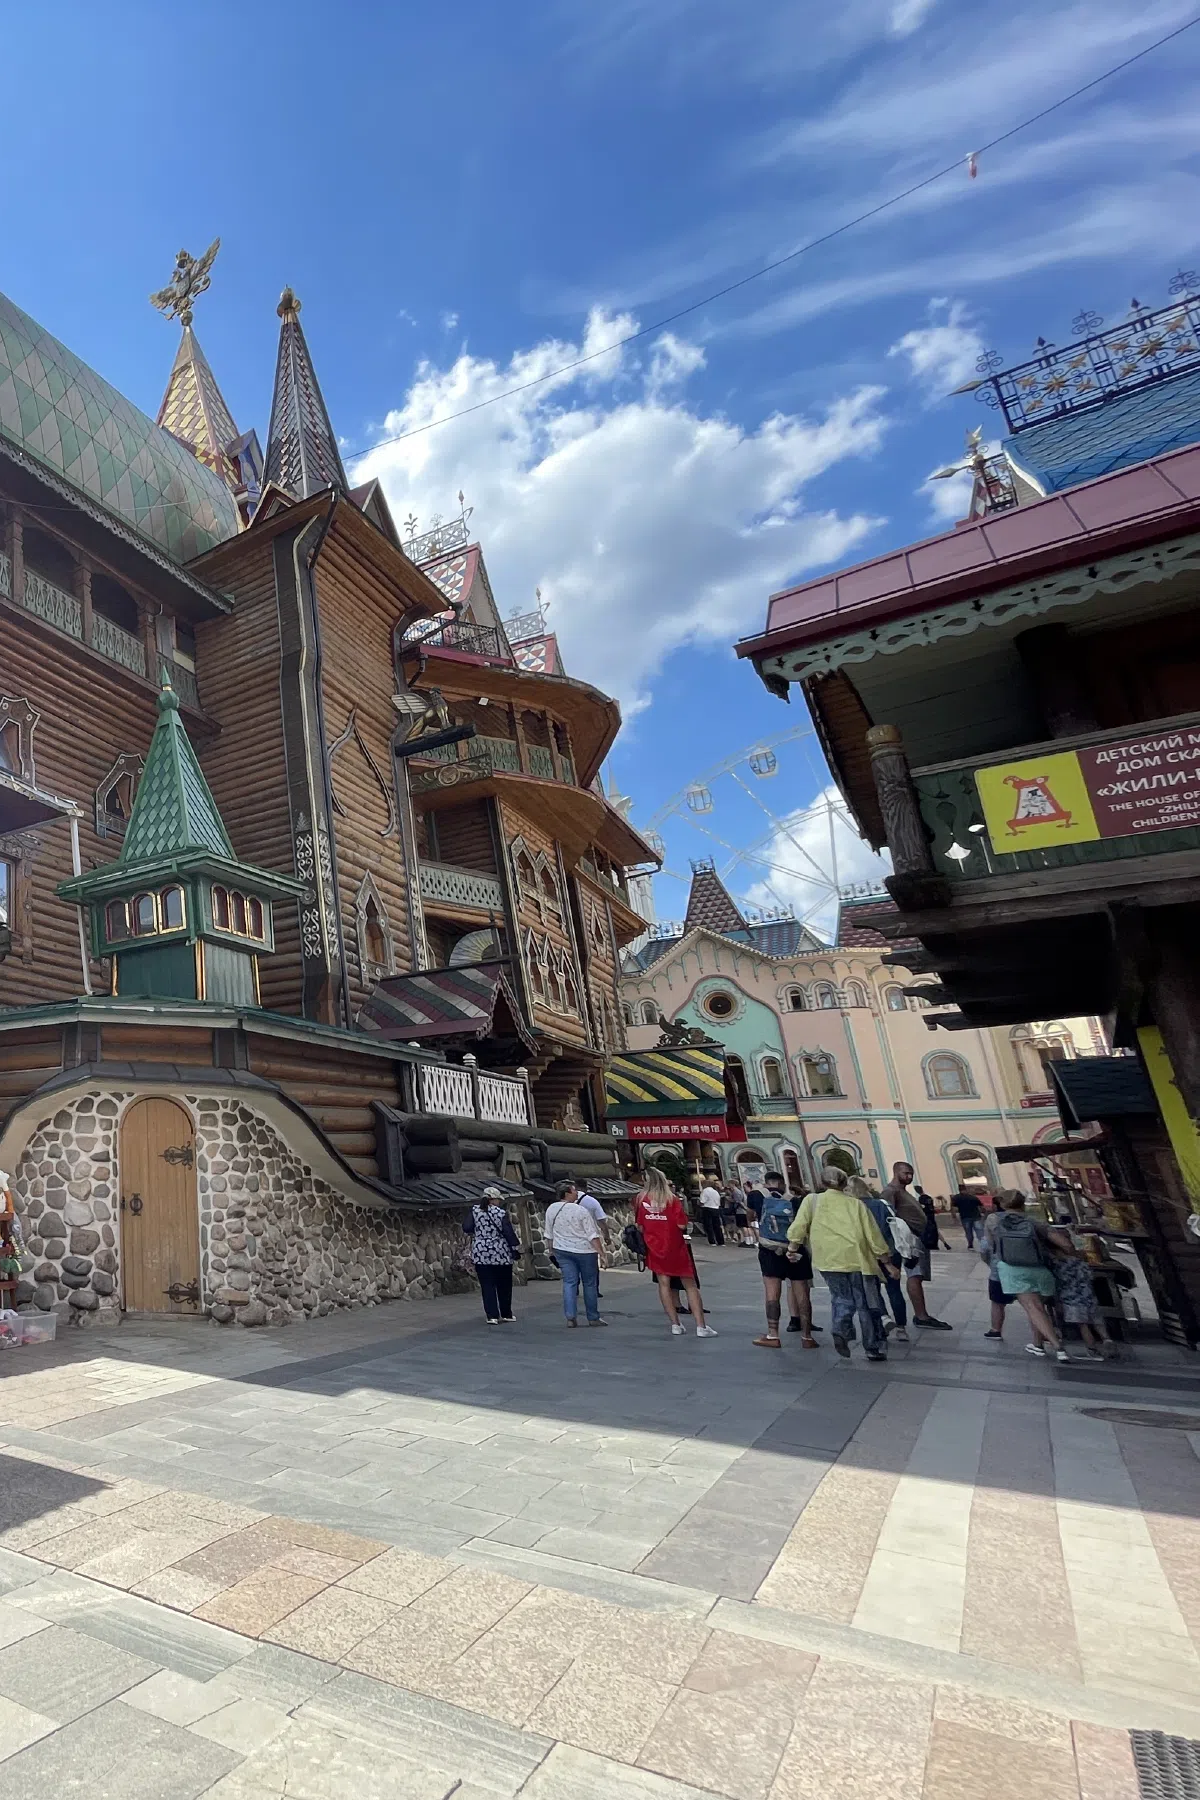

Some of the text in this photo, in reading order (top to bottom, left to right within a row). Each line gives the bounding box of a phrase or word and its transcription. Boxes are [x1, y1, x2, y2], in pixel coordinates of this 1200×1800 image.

[1096, 735, 1183, 764] ДЕТСКИЙ
[1116, 748, 1200, 775] ДОМ СКА
[1108, 791, 1200, 812] THE HOUSE OF
[633, 1124, 720, 1134] 伏特加酒历史博物馆
[644, 1213, 668, 1221] adidas
